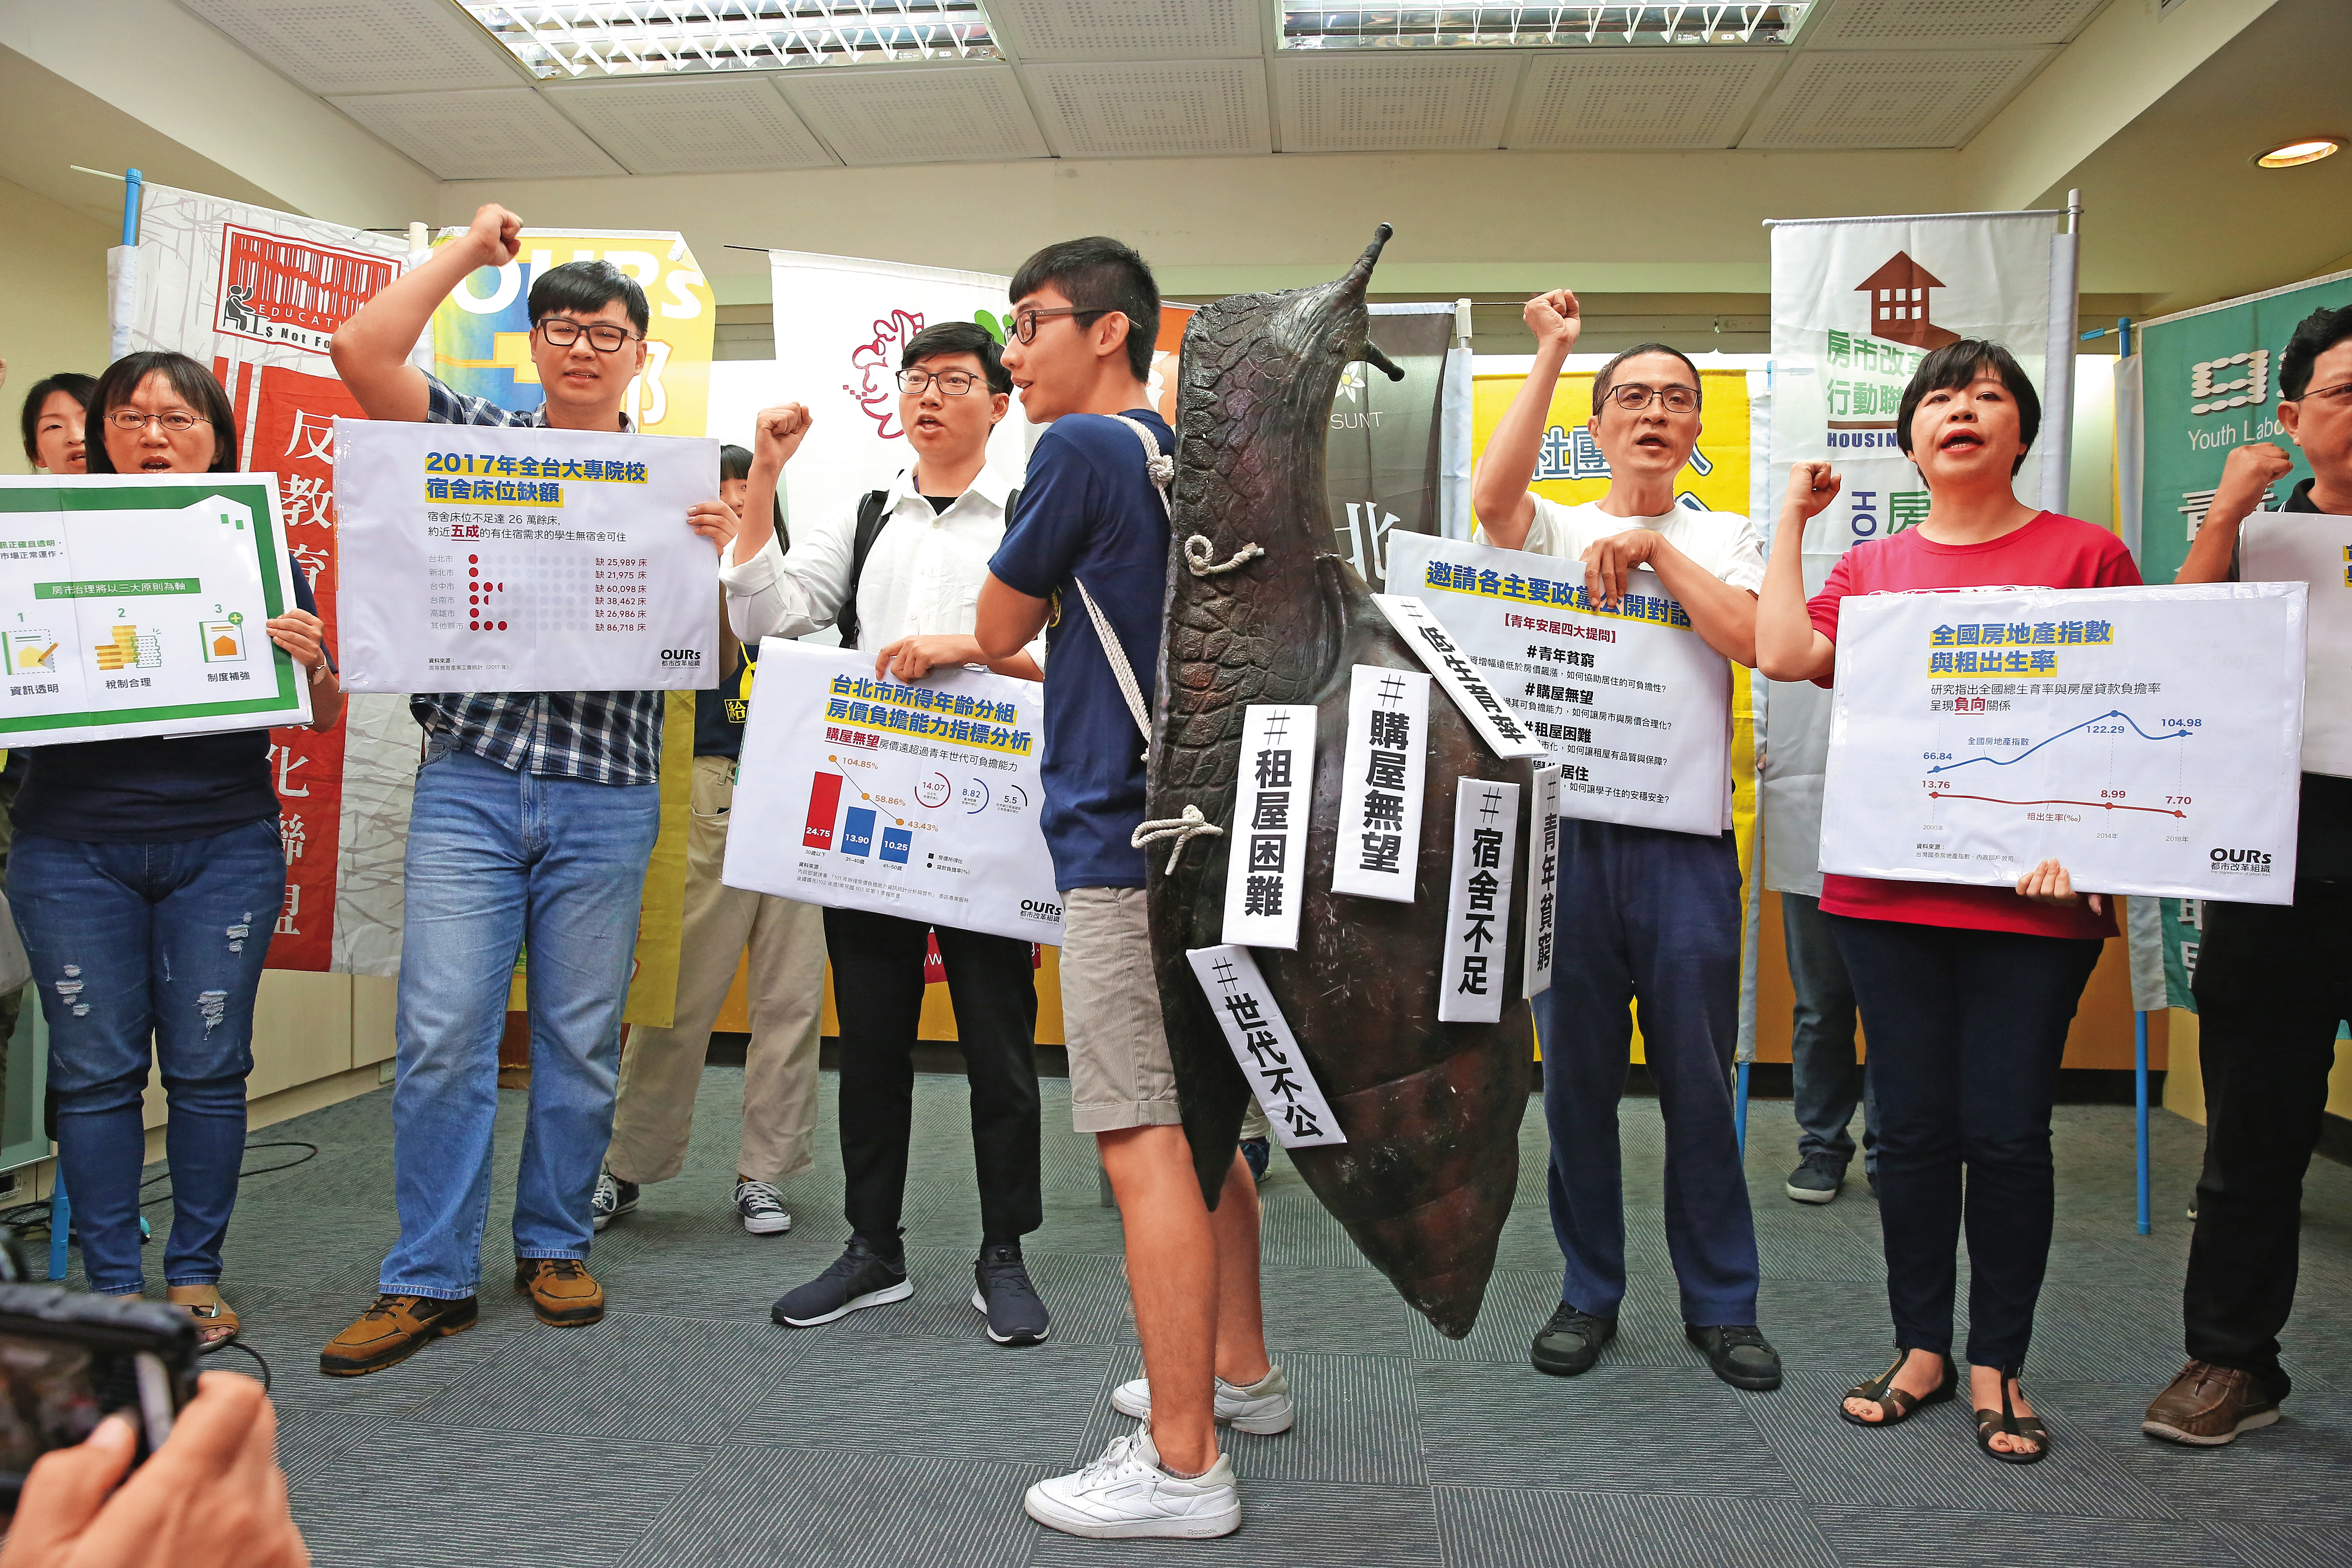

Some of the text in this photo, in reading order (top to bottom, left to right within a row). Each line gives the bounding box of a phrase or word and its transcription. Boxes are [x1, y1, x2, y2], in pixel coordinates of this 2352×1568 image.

[259, 305, 341, 327] EDUCATI
[281, 328, 306, 344] Not
[315, 337, 330, 348] Fo
[1827, 379, 1904, 415] 行動聯
[1330, 412, 1383, 430] SUNT
[2188, 416, 2285, 450] Youth Labo
[1827, 432, 1897, 448] HOUSIN
[427, 452, 646, 482] 2017年全台大專院校
[427, 478, 559, 503] 宿舍床位缺額
[428, 512, 505, 524] 宿舍床位不足達
[509, 515, 523, 523] 26
[0, 550, 63, 560] 市場正常運作。
[429, 555, 647, 568] 台北市 缺 25,989 床
[595, 571, 604, 579] 缺
[607, 572, 634, 580] 21,975
[638, 571, 647, 579] 床
[52, 581, 186, 595] 房市治理將以三大原則為軸
[595, 585, 604, 593] 缺
[607, 586, 636, 594] 60,098
[638, 586, 647, 594] 床
[430, 596, 647, 606] 台南市 缺 38,462 床
[118, 608, 126, 618] 2
[215, 604, 222, 614] 3
[430, 609, 647, 619] 高雄市 缺 26,986 床
[18, 612, 24, 622] 1
[430, 622, 646, 633] 其他縣市 缺 86,718 床
[1505, 613, 1616, 645] 【青年安居四大提問】
[1932, 620, 2111, 646] 全國房地產指數
[661, 649, 701, 659] OURs
[1527, 645, 1595, 668] #青年貧窮
[1930, 649, 2055, 673] 與粗出生率
[207, 671, 250, 682] 制度補強
[1401, 600, 1527, 744] #低生育率
[1466, 655, 1666, 693] 資增幅遠低於房價飆漲，如何協助居住的可負擔性?
[105, 677, 151, 689] 稅制合理
[1931, 682, 2161, 695] 研究指出全國總生育率與房屋貸款負擔率
[10, 684, 59, 696] 資訊透明
[1525, 682, 1594, 706] #購屋無望
[833, 673, 1016, 724] 台北市所得年齡分組
[1930, 697, 2011, 712] 呈現負向關係
[728, 701, 748, 720] 給
[1502, 696, 1672, 730] 過其可負擔能力，如何讓房市與房價合理化?
[828, 698, 1031, 751] 房價負擔能力指標分析
[2162, 718, 2202, 727] 104.98
[2086, 725, 2125, 735] 122.29
[1968, 737, 2029, 746] 全國房地產指數
[1538, 740, 1667, 766] 市化，如何讓租屋有品質與保障?
[1923, 752, 1953, 761] 66.84
[842, 757, 878, 770] 104.85%
[1360, 676, 1410, 875] #購屋無望
[922, 782, 945, 791] 14.07
[1922, 780, 1950, 789] 13.76
[962, 788, 980, 798] 8.82
[2100, 790, 2126, 799] 8.99
[875, 795, 906, 806] 58.86%
[1004, 795, 1018, 804] 5.5
[2166, 796, 2192, 805] 7.70
[1245, 709, 1292, 918] #租屋困難
[806, 827, 831, 837] 24.75
[907, 821, 939, 832] 43.43%
[845, 834, 869, 844] 13.90
[884, 841, 908, 851] 10.25
[938, 855, 963, 864] 房價所得比
[2210, 848, 2272, 864] OURs
[2210, 862, 2270, 873] 都市改革組織
[1537, 775, 1558, 973] #青年貧窮
[1457, 786, 1504, 996] #宿舍不足
[1020, 900, 1062, 915] OURs
[1020, 910, 1060, 922] 都市改革組織
[1212, 956, 1324, 1139] #世代不公
